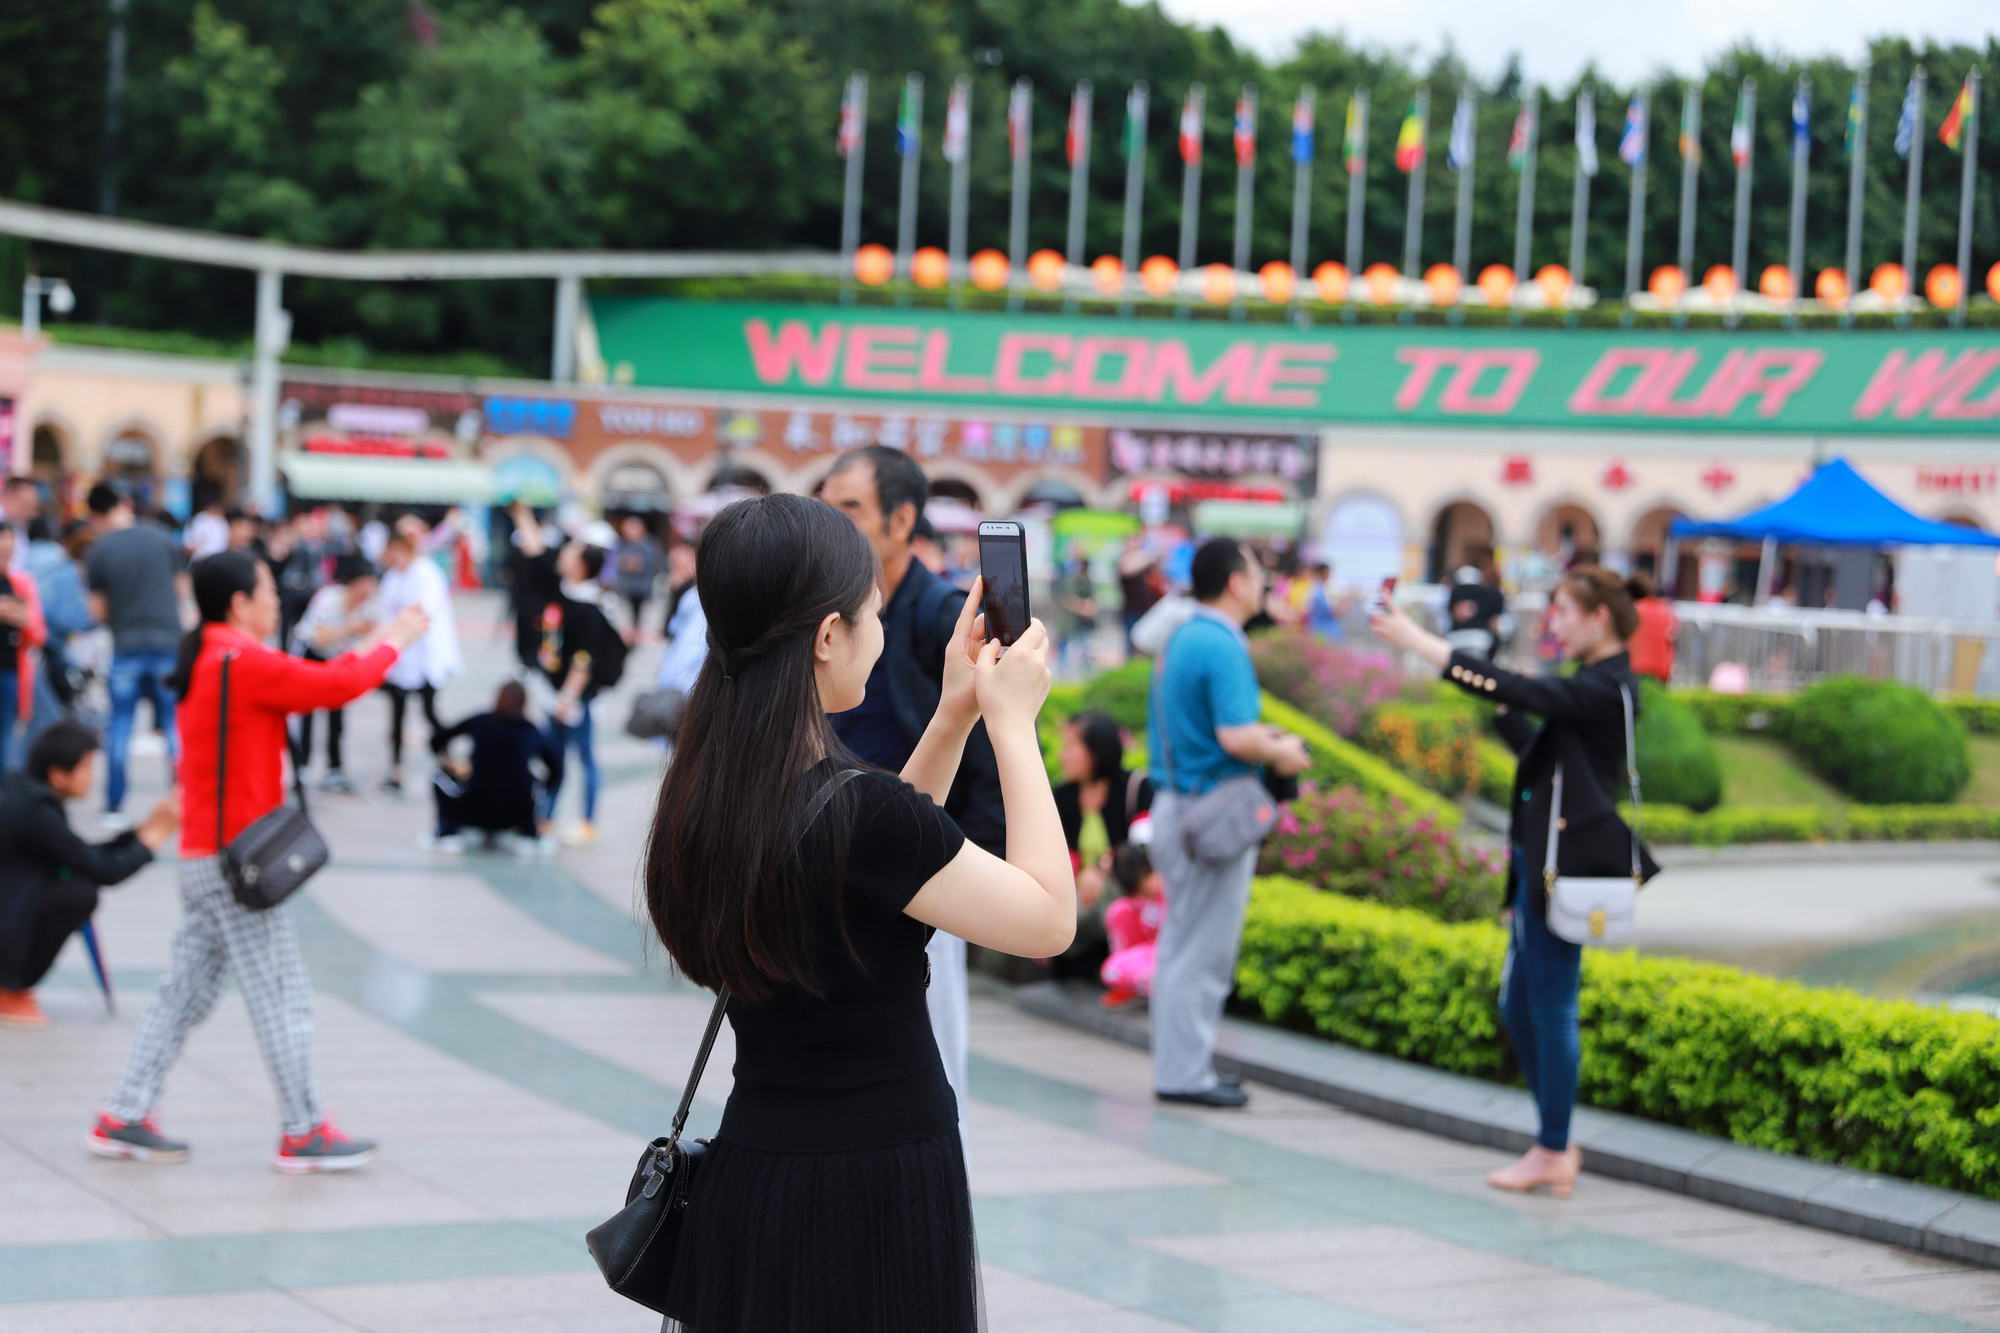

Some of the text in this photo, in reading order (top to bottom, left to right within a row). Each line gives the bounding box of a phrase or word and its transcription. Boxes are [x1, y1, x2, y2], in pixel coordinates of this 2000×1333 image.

[744, 318, 1338, 409] WELCOME
[1394, 345, 1541, 415] TO
[1566, 345, 1825, 418] OUR
